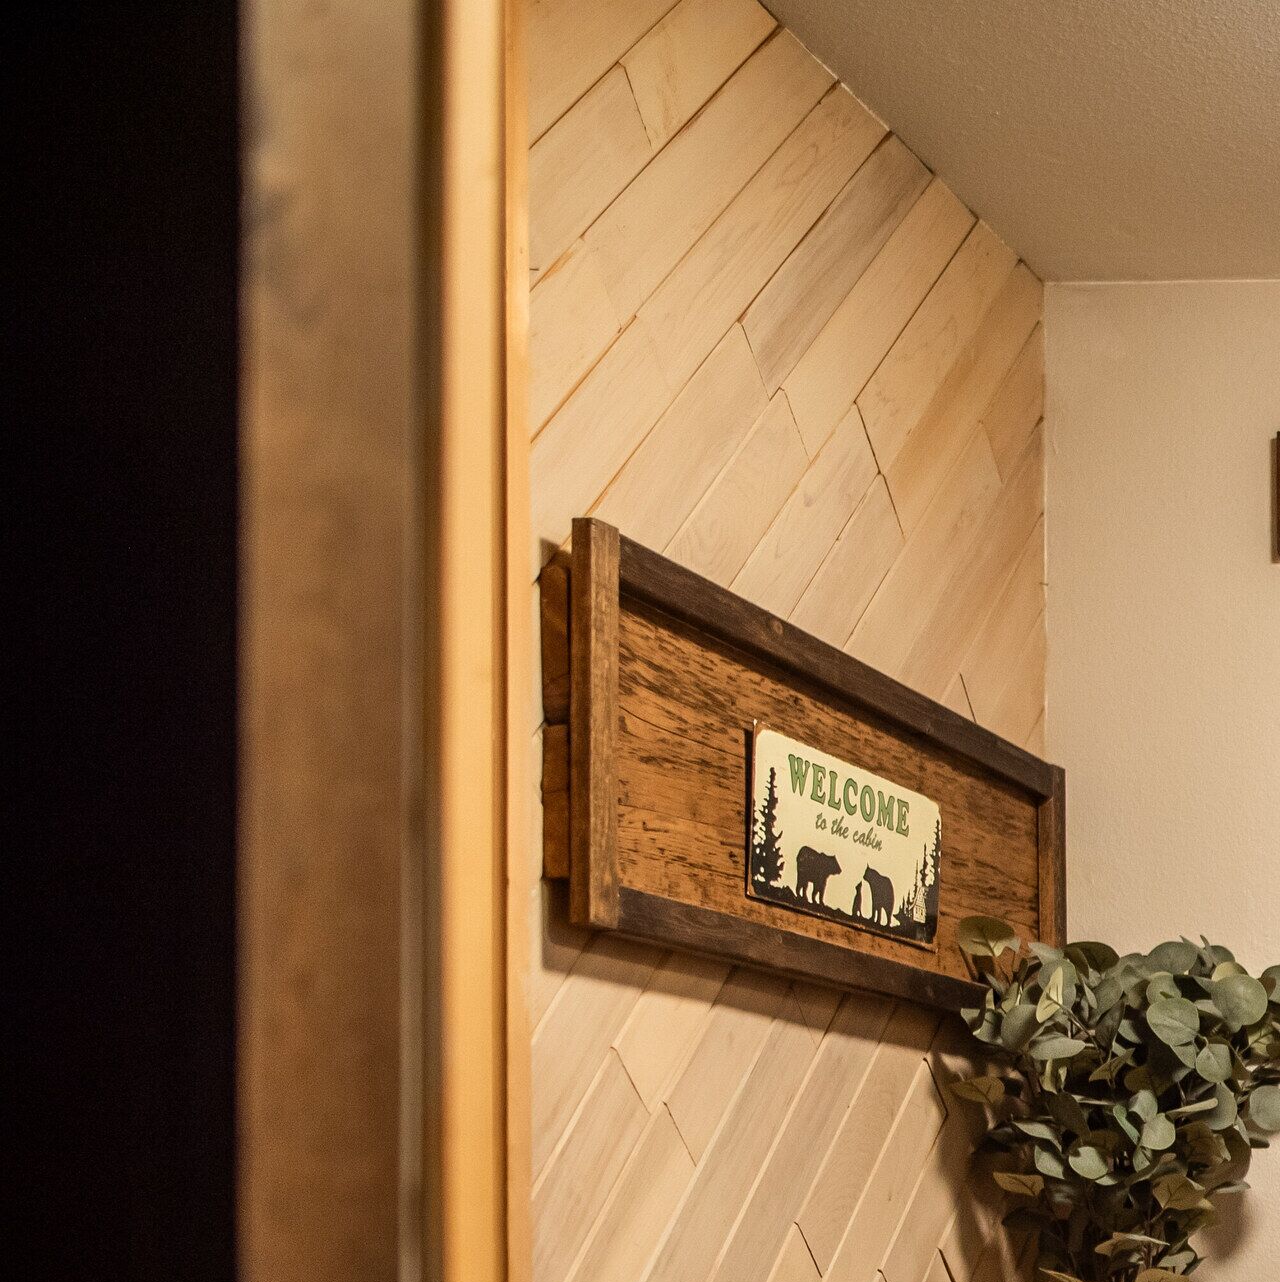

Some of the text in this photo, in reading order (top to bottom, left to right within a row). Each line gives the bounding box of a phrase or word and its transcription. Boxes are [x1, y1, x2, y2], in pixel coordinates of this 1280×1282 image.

[788, 753, 910, 838] WELCOME
[815, 812, 883, 852] to the cabin
